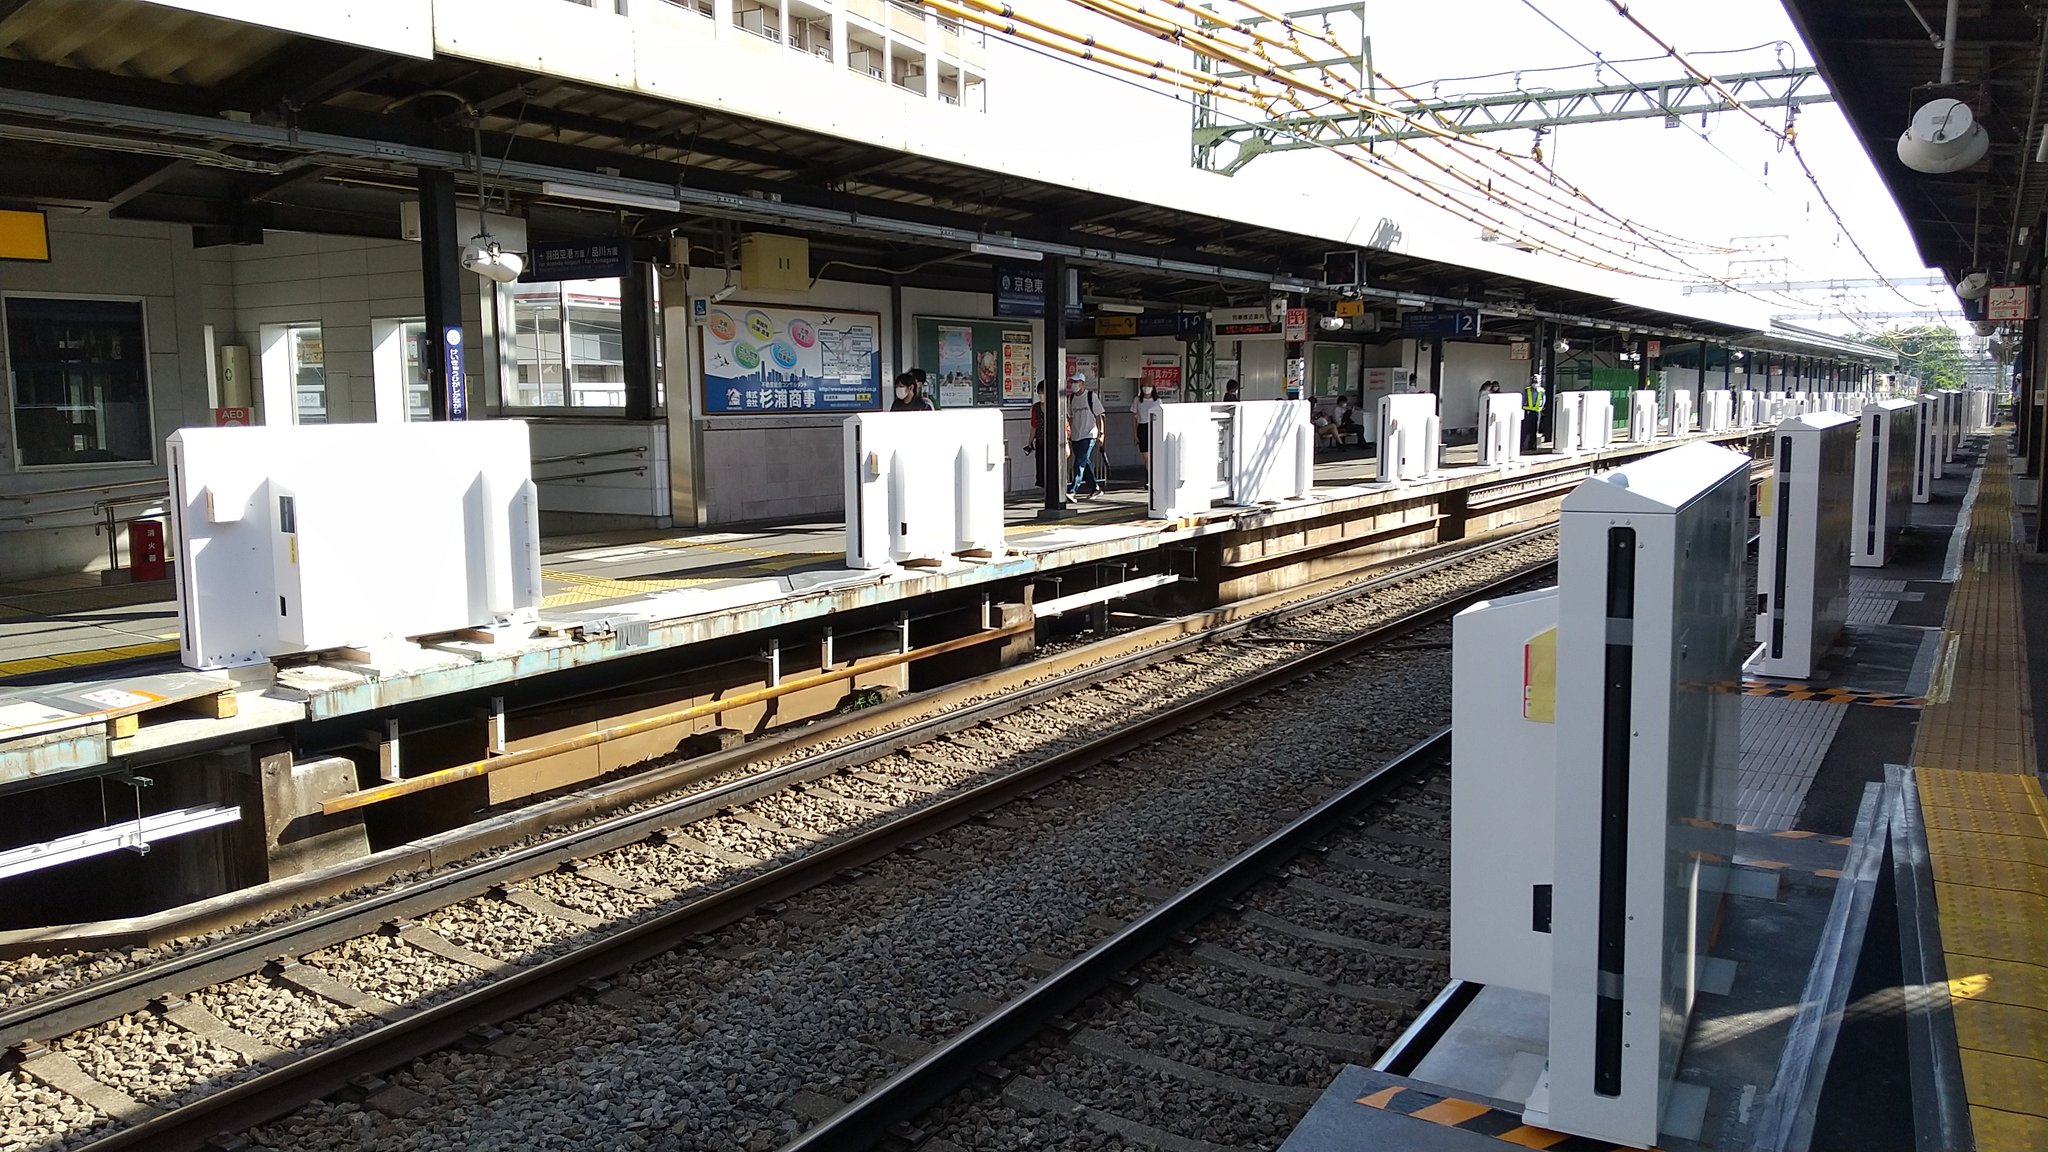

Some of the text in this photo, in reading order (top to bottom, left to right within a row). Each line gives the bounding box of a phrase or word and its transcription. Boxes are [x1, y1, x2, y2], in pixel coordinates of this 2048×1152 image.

[1182, 318, 1189, 329] 1
[1461, 315, 1473, 331] 2
[759, 388, 816, 409] 杉浦商事
[221, 409, 244, 419] AED
